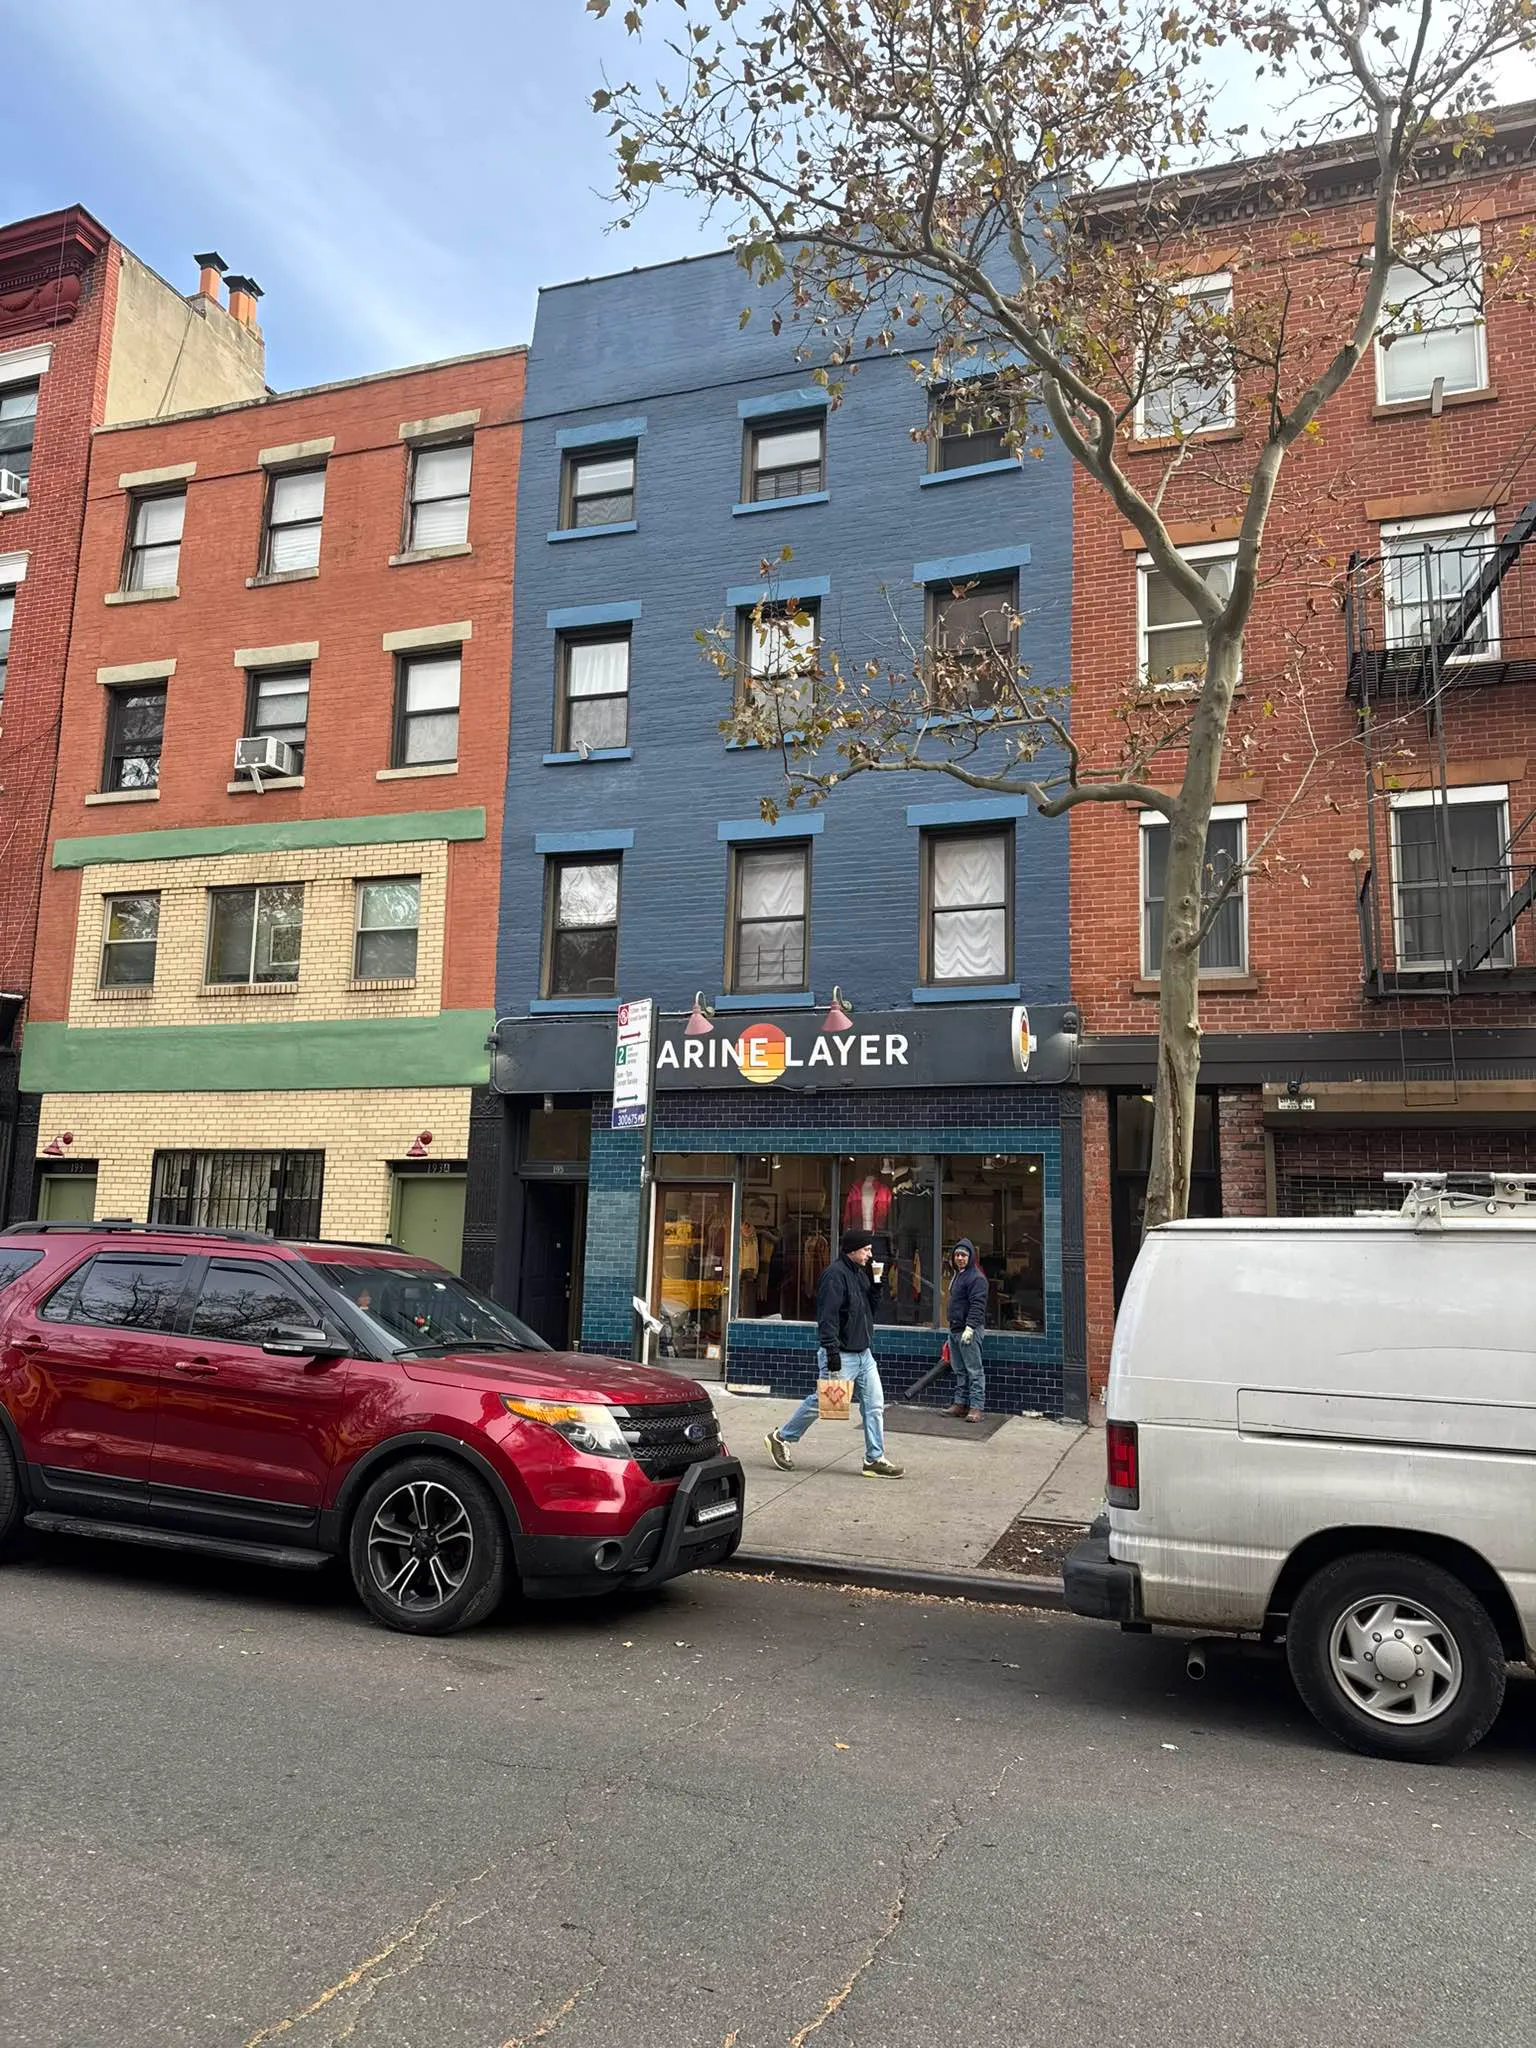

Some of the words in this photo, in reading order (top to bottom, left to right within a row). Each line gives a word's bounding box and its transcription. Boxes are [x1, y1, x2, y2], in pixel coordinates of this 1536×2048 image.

[618, 1047, 625, 1064] 2
[656, 1038, 768, 1068] ARINE
[785, 1034, 909, 1067] LAYER
